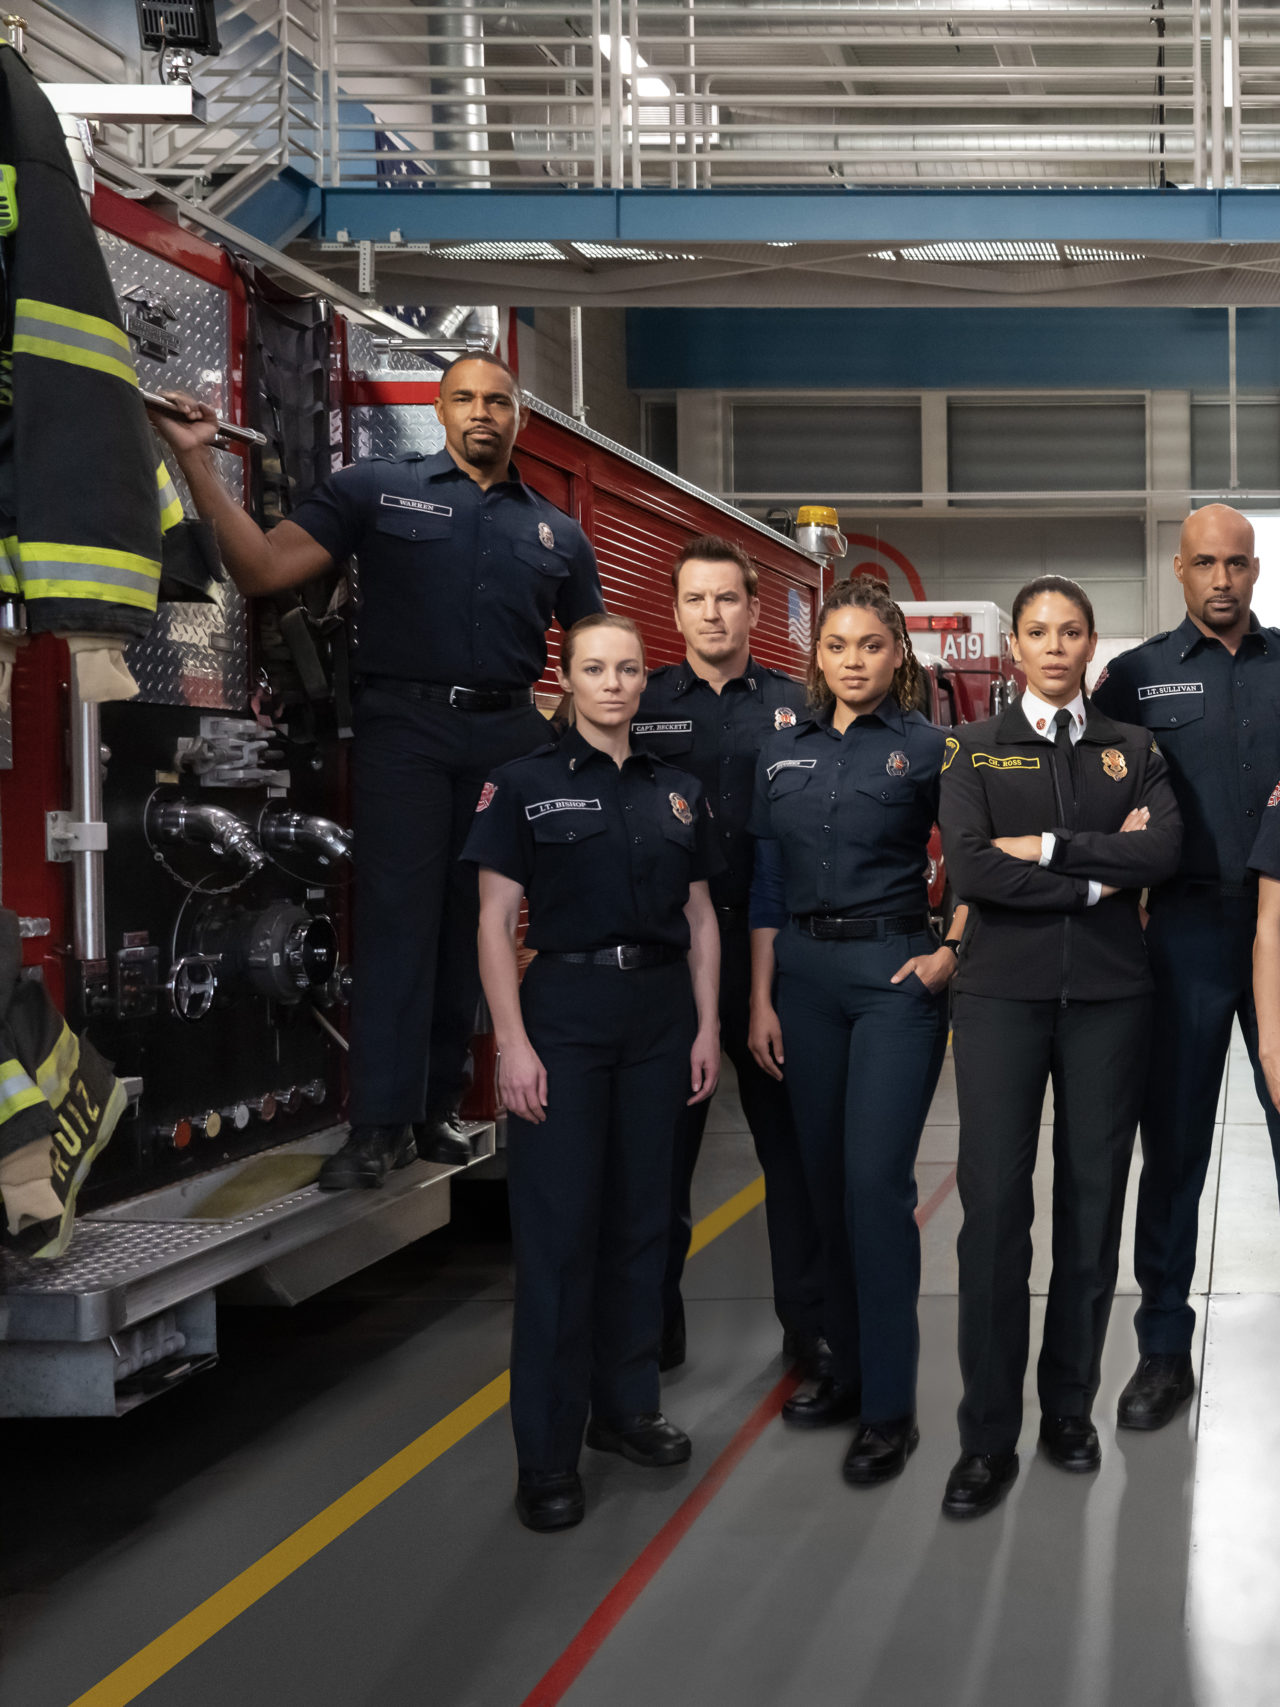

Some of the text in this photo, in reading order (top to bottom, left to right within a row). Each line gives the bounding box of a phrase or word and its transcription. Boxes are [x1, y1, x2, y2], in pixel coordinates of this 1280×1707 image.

[399, 499, 434, 511] WARREN
[943, 634, 982, 660] A19
[1160, 685, 1197, 694] SULLIVAN
[1002, 759, 1022, 767] ROSS
[555, 801, 587, 809] BISHOP
